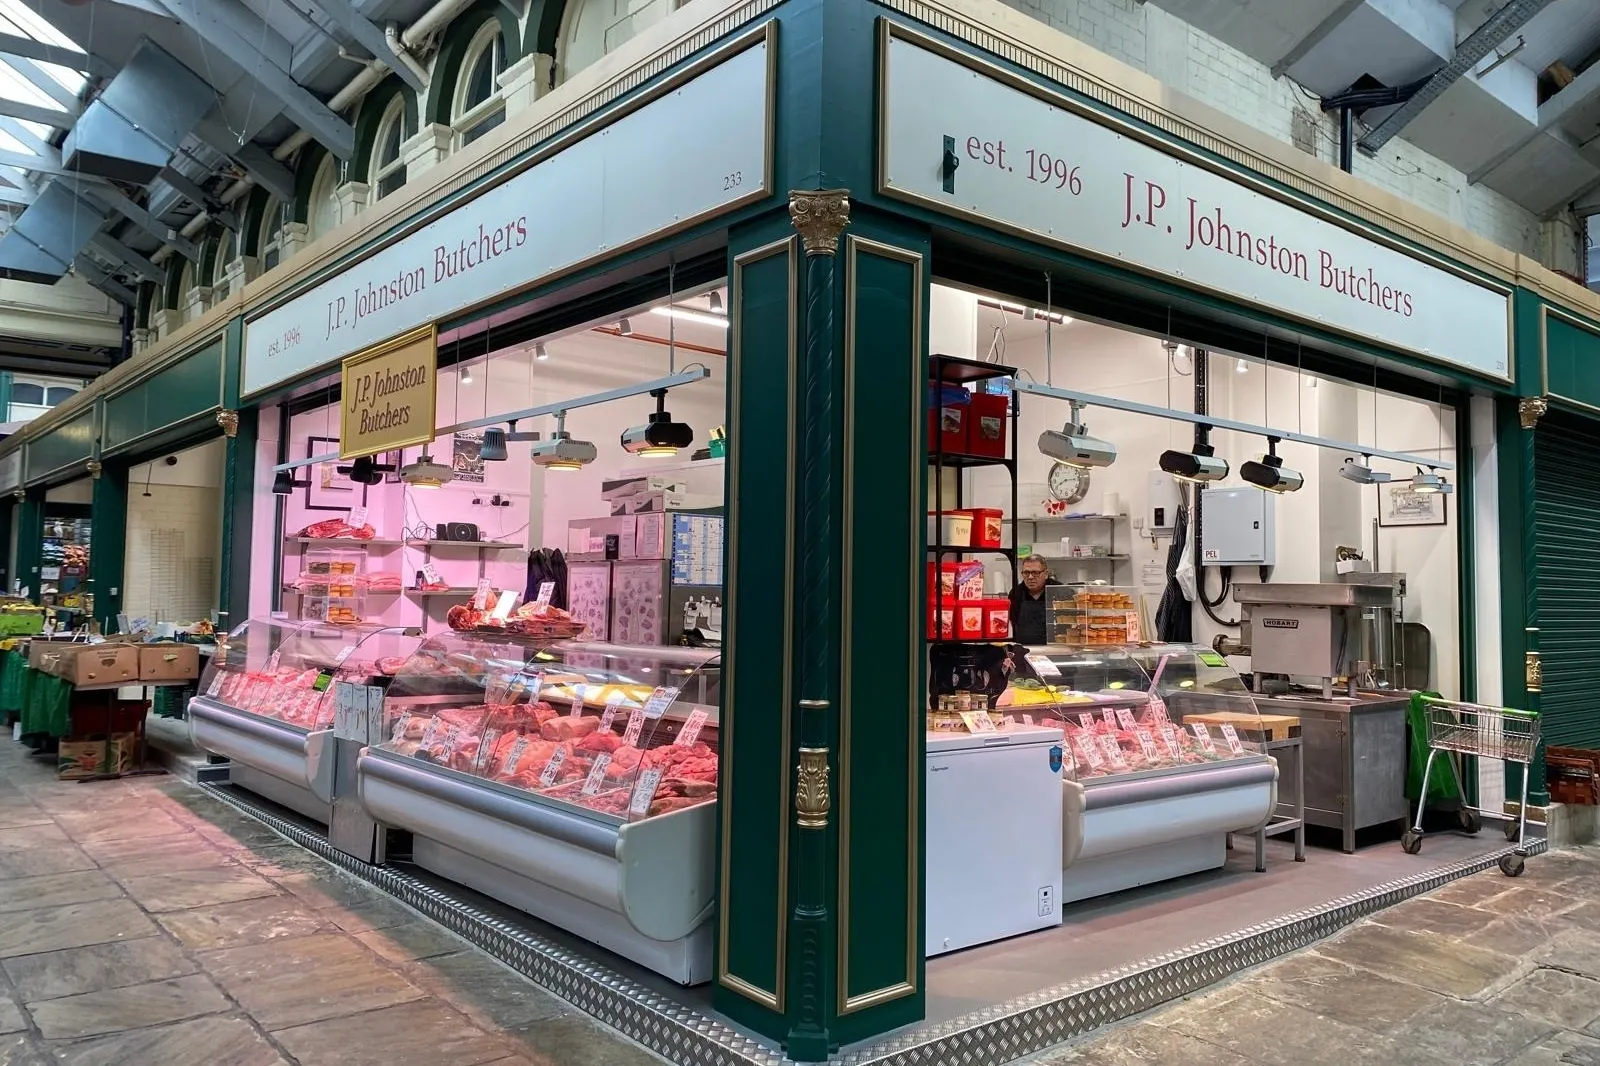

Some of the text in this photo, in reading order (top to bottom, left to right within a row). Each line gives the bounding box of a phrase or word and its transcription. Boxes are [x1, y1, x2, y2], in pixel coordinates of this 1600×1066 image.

[723, 171, 742, 191] 233
[966, 136, 1413, 318] est. 1996 J.P. Johnston Butchers
[268, 216, 528, 357] est. 1996 J.P. Johnston Butchers
[351, 364, 427, 414] J.P. Johnston
[358, 402, 411, 436] Butchers
[1205, 550, 1218, 558] PEL
